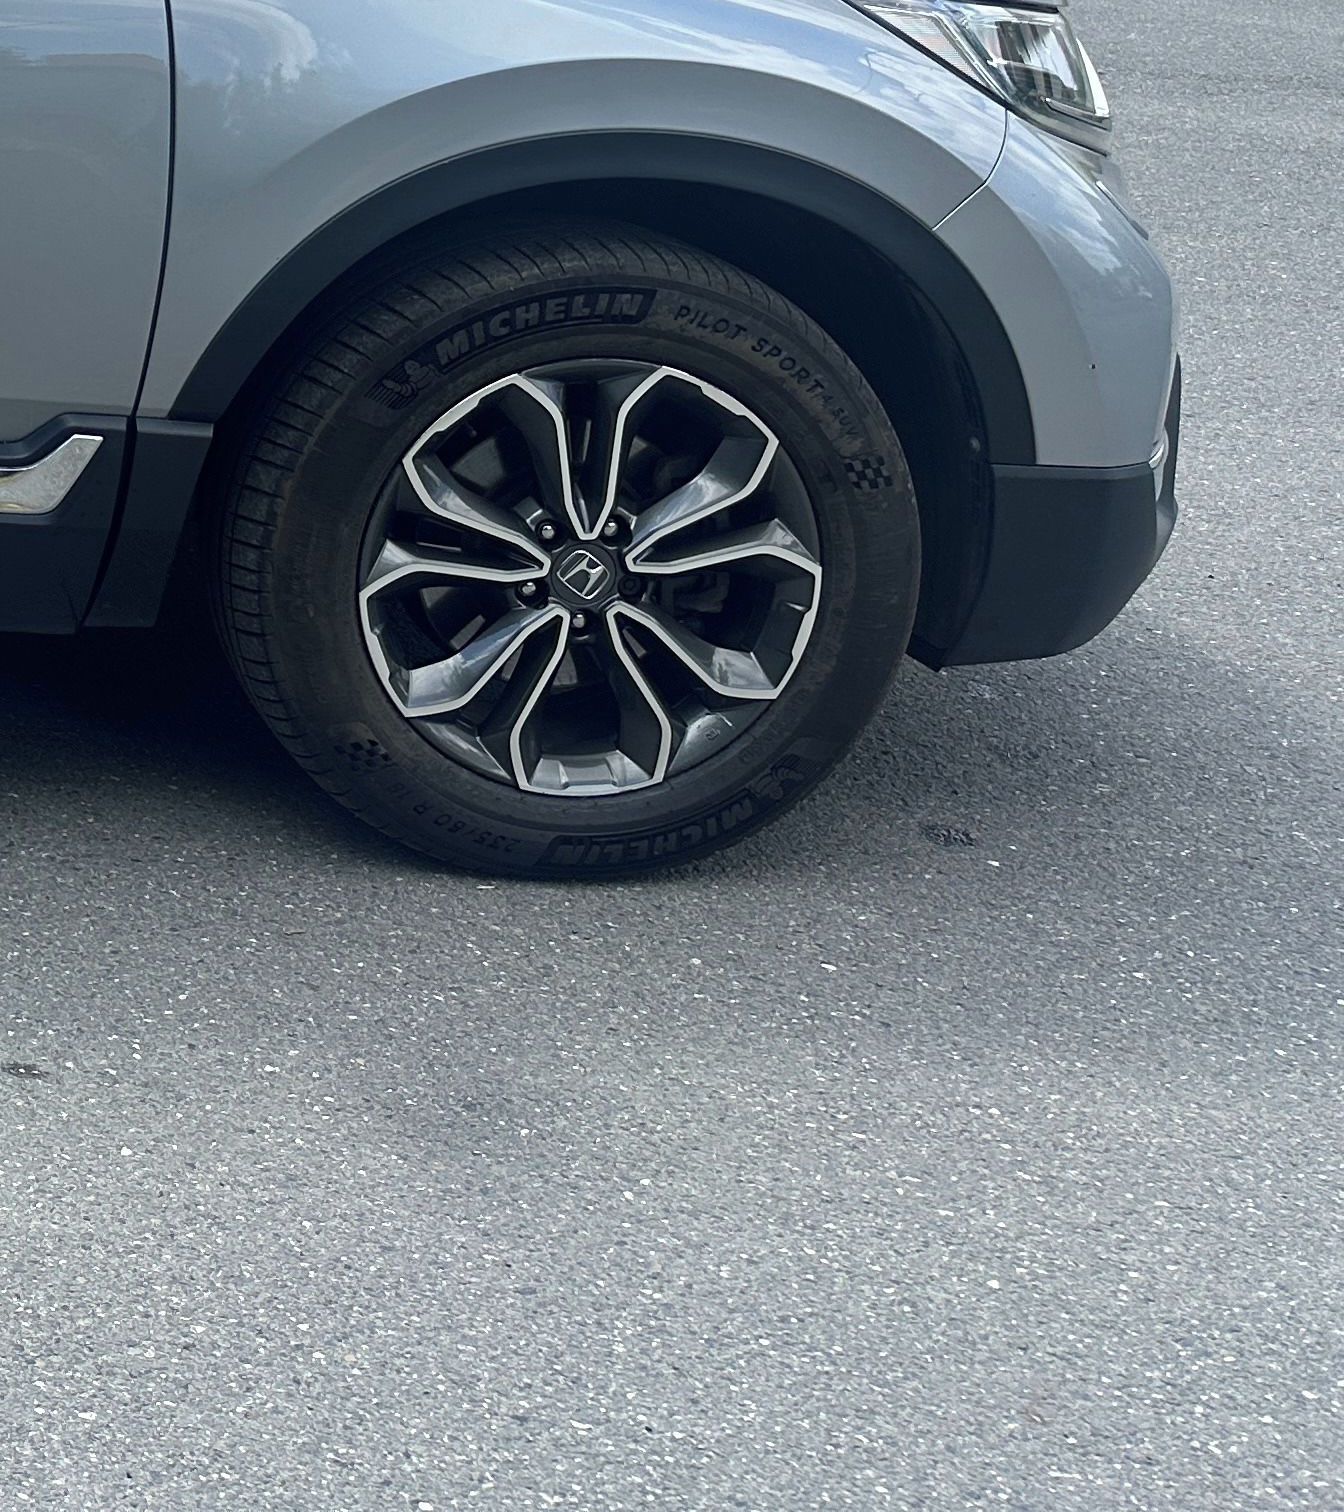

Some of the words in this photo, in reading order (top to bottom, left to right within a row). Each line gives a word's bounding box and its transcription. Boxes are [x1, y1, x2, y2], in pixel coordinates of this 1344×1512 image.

[434, 292, 645, 366] MICHELIN
[673, 304, 748, 340] PILOT
[751, 336, 826, 395] SPORT
[832, 406, 861, 436] SUV
[549, 797, 754, 865] MICHELIN
